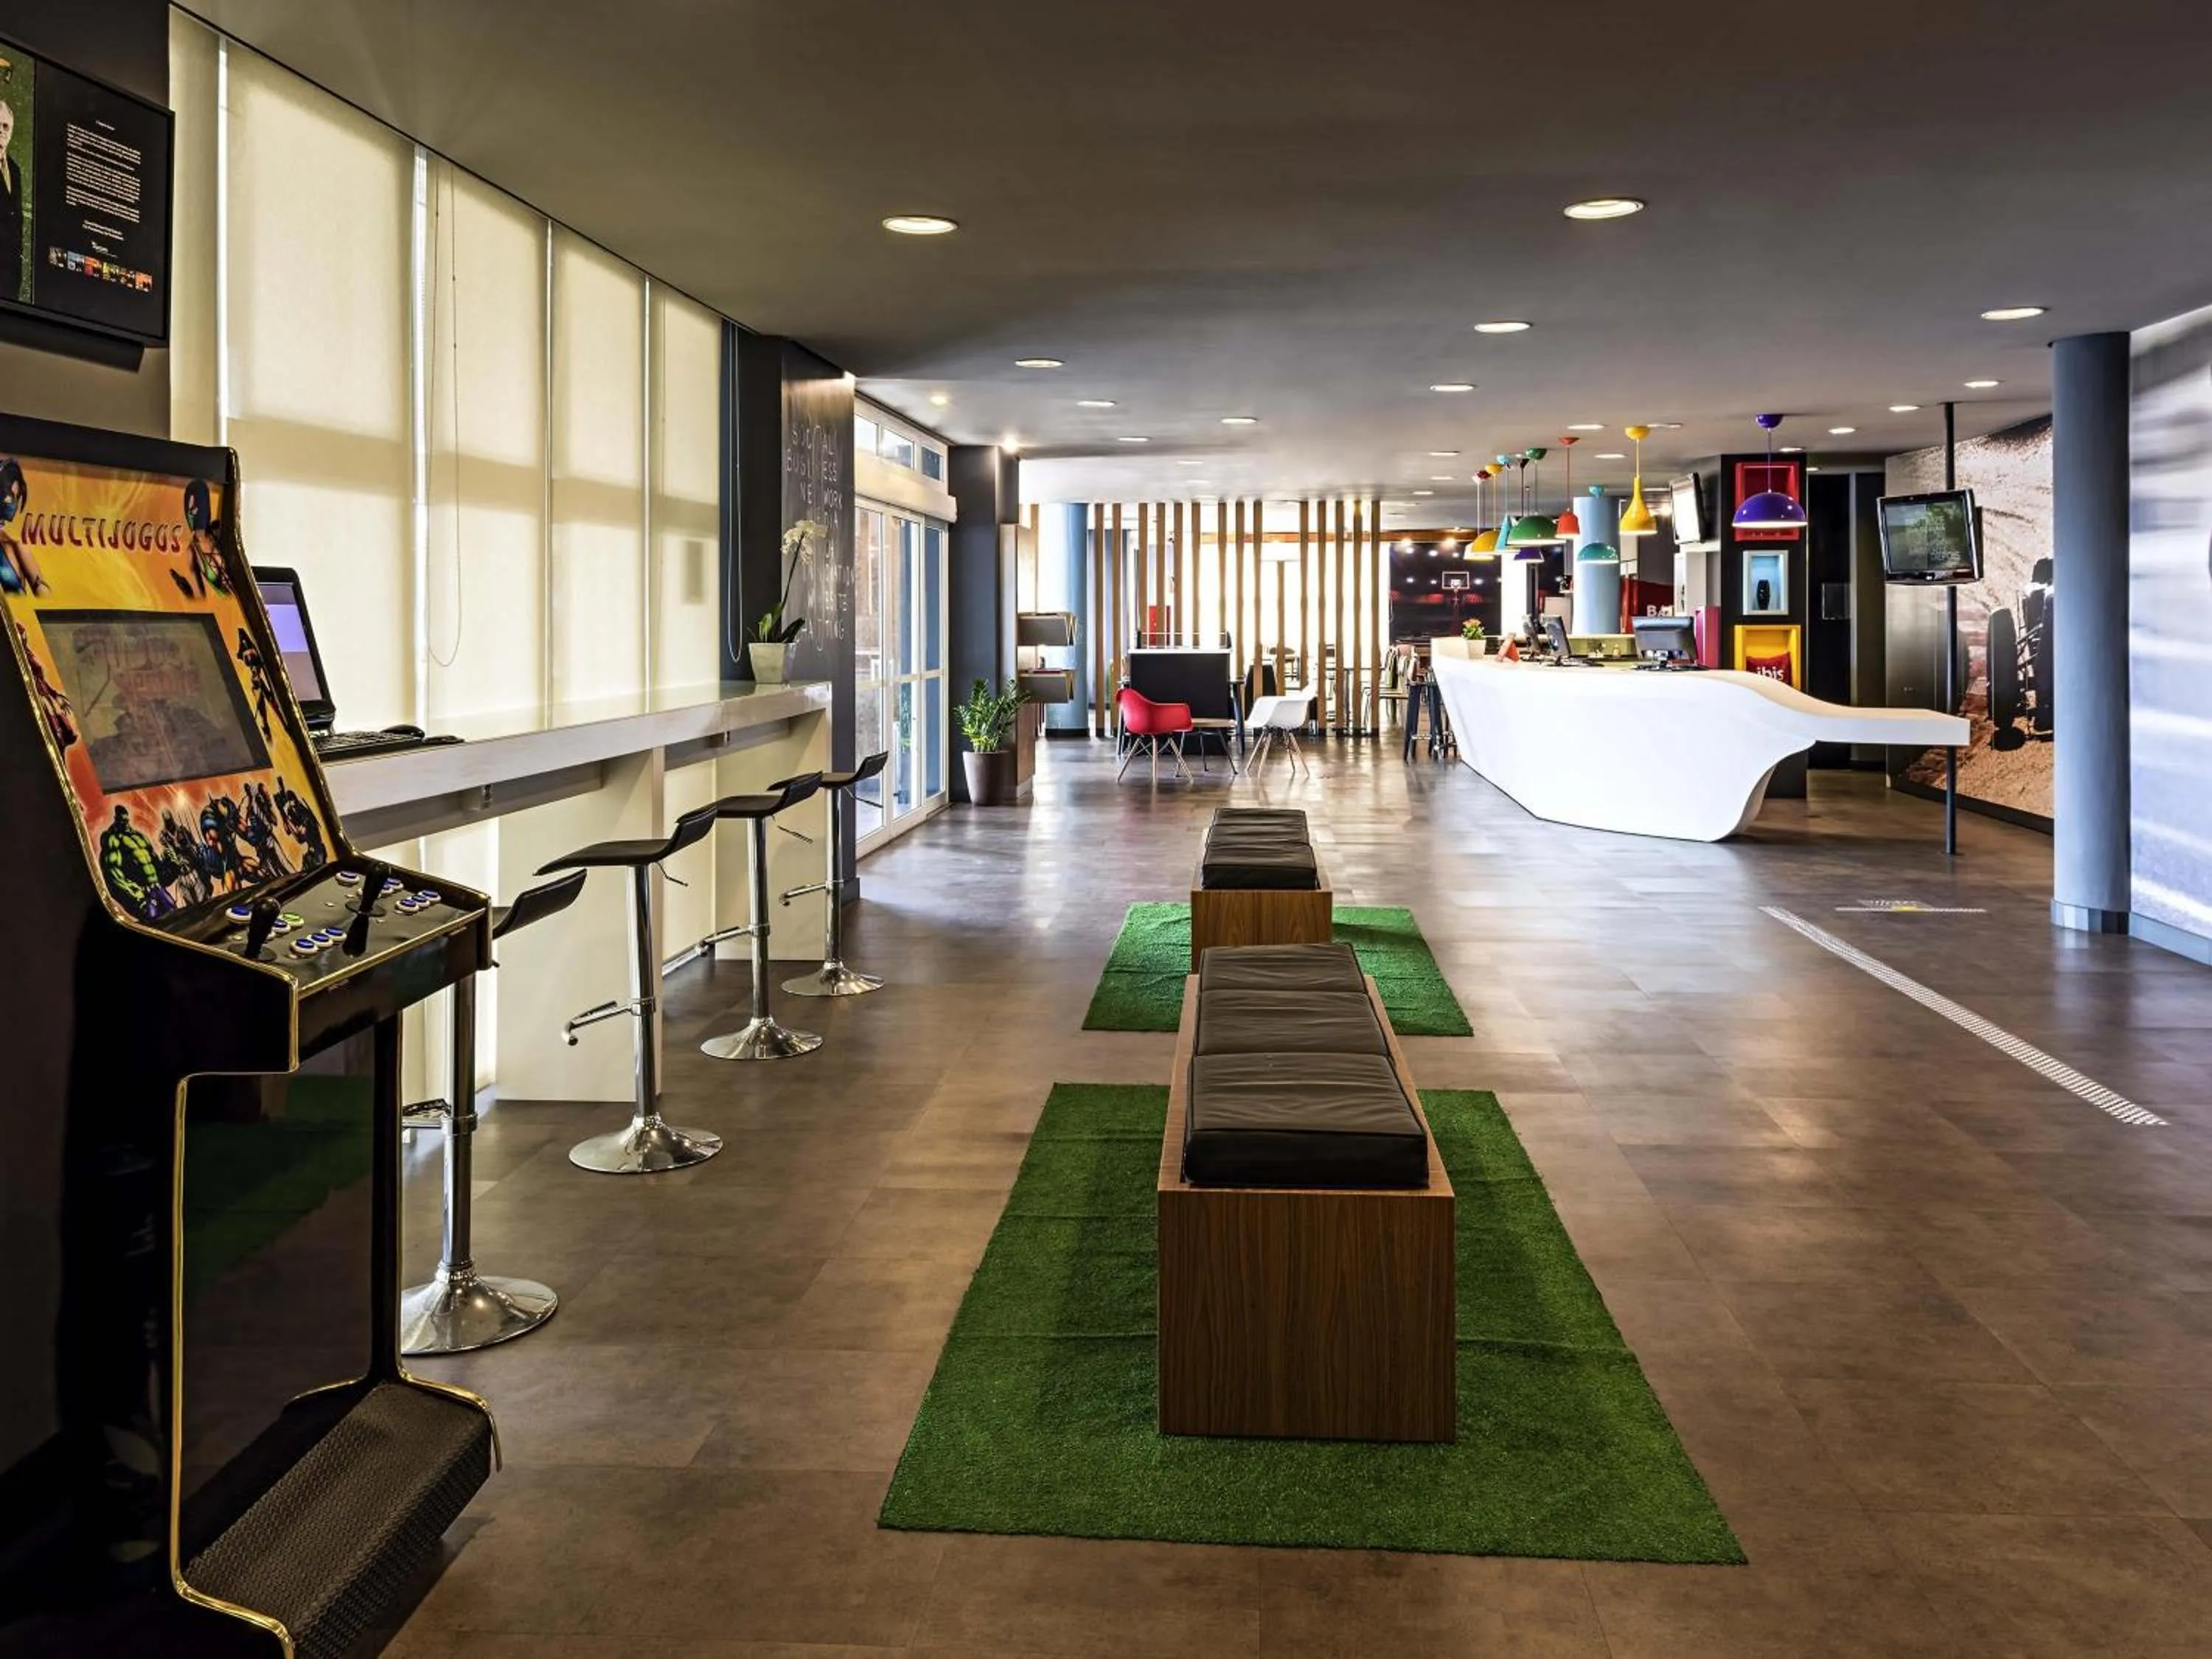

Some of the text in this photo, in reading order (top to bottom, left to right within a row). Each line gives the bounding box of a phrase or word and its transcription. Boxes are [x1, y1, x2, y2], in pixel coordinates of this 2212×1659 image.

[786, 448, 838, 482] BUSIESS
[800, 482, 843, 509] NEWORK
[21, 512, 182, 553] MULTIJOGOS
[1756, 666, 1784, 680] ibis
